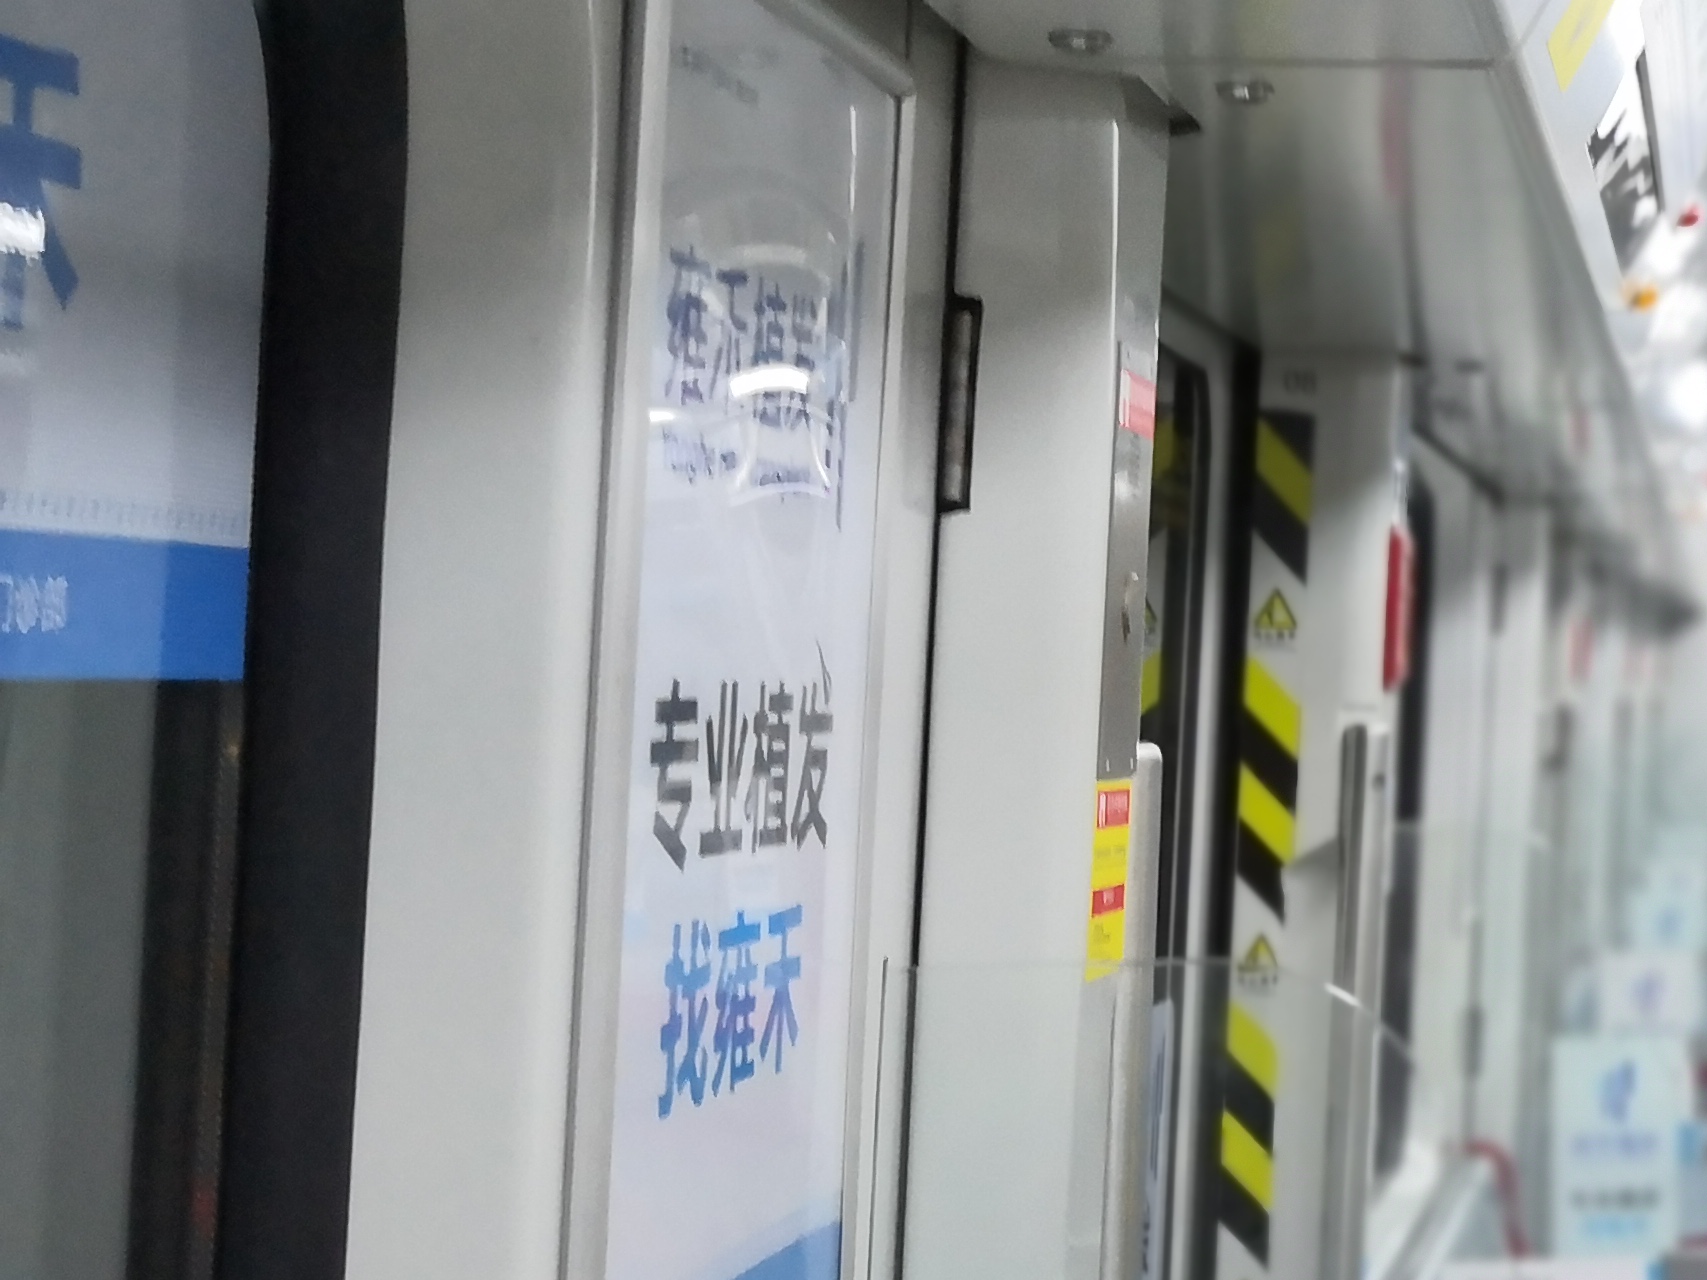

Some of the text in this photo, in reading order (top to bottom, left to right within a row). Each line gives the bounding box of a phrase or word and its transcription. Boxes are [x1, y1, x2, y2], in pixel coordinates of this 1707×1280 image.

[650, 640, 832, 871] 专业植发
[658, 904, 802, 1120] 找雍禾
